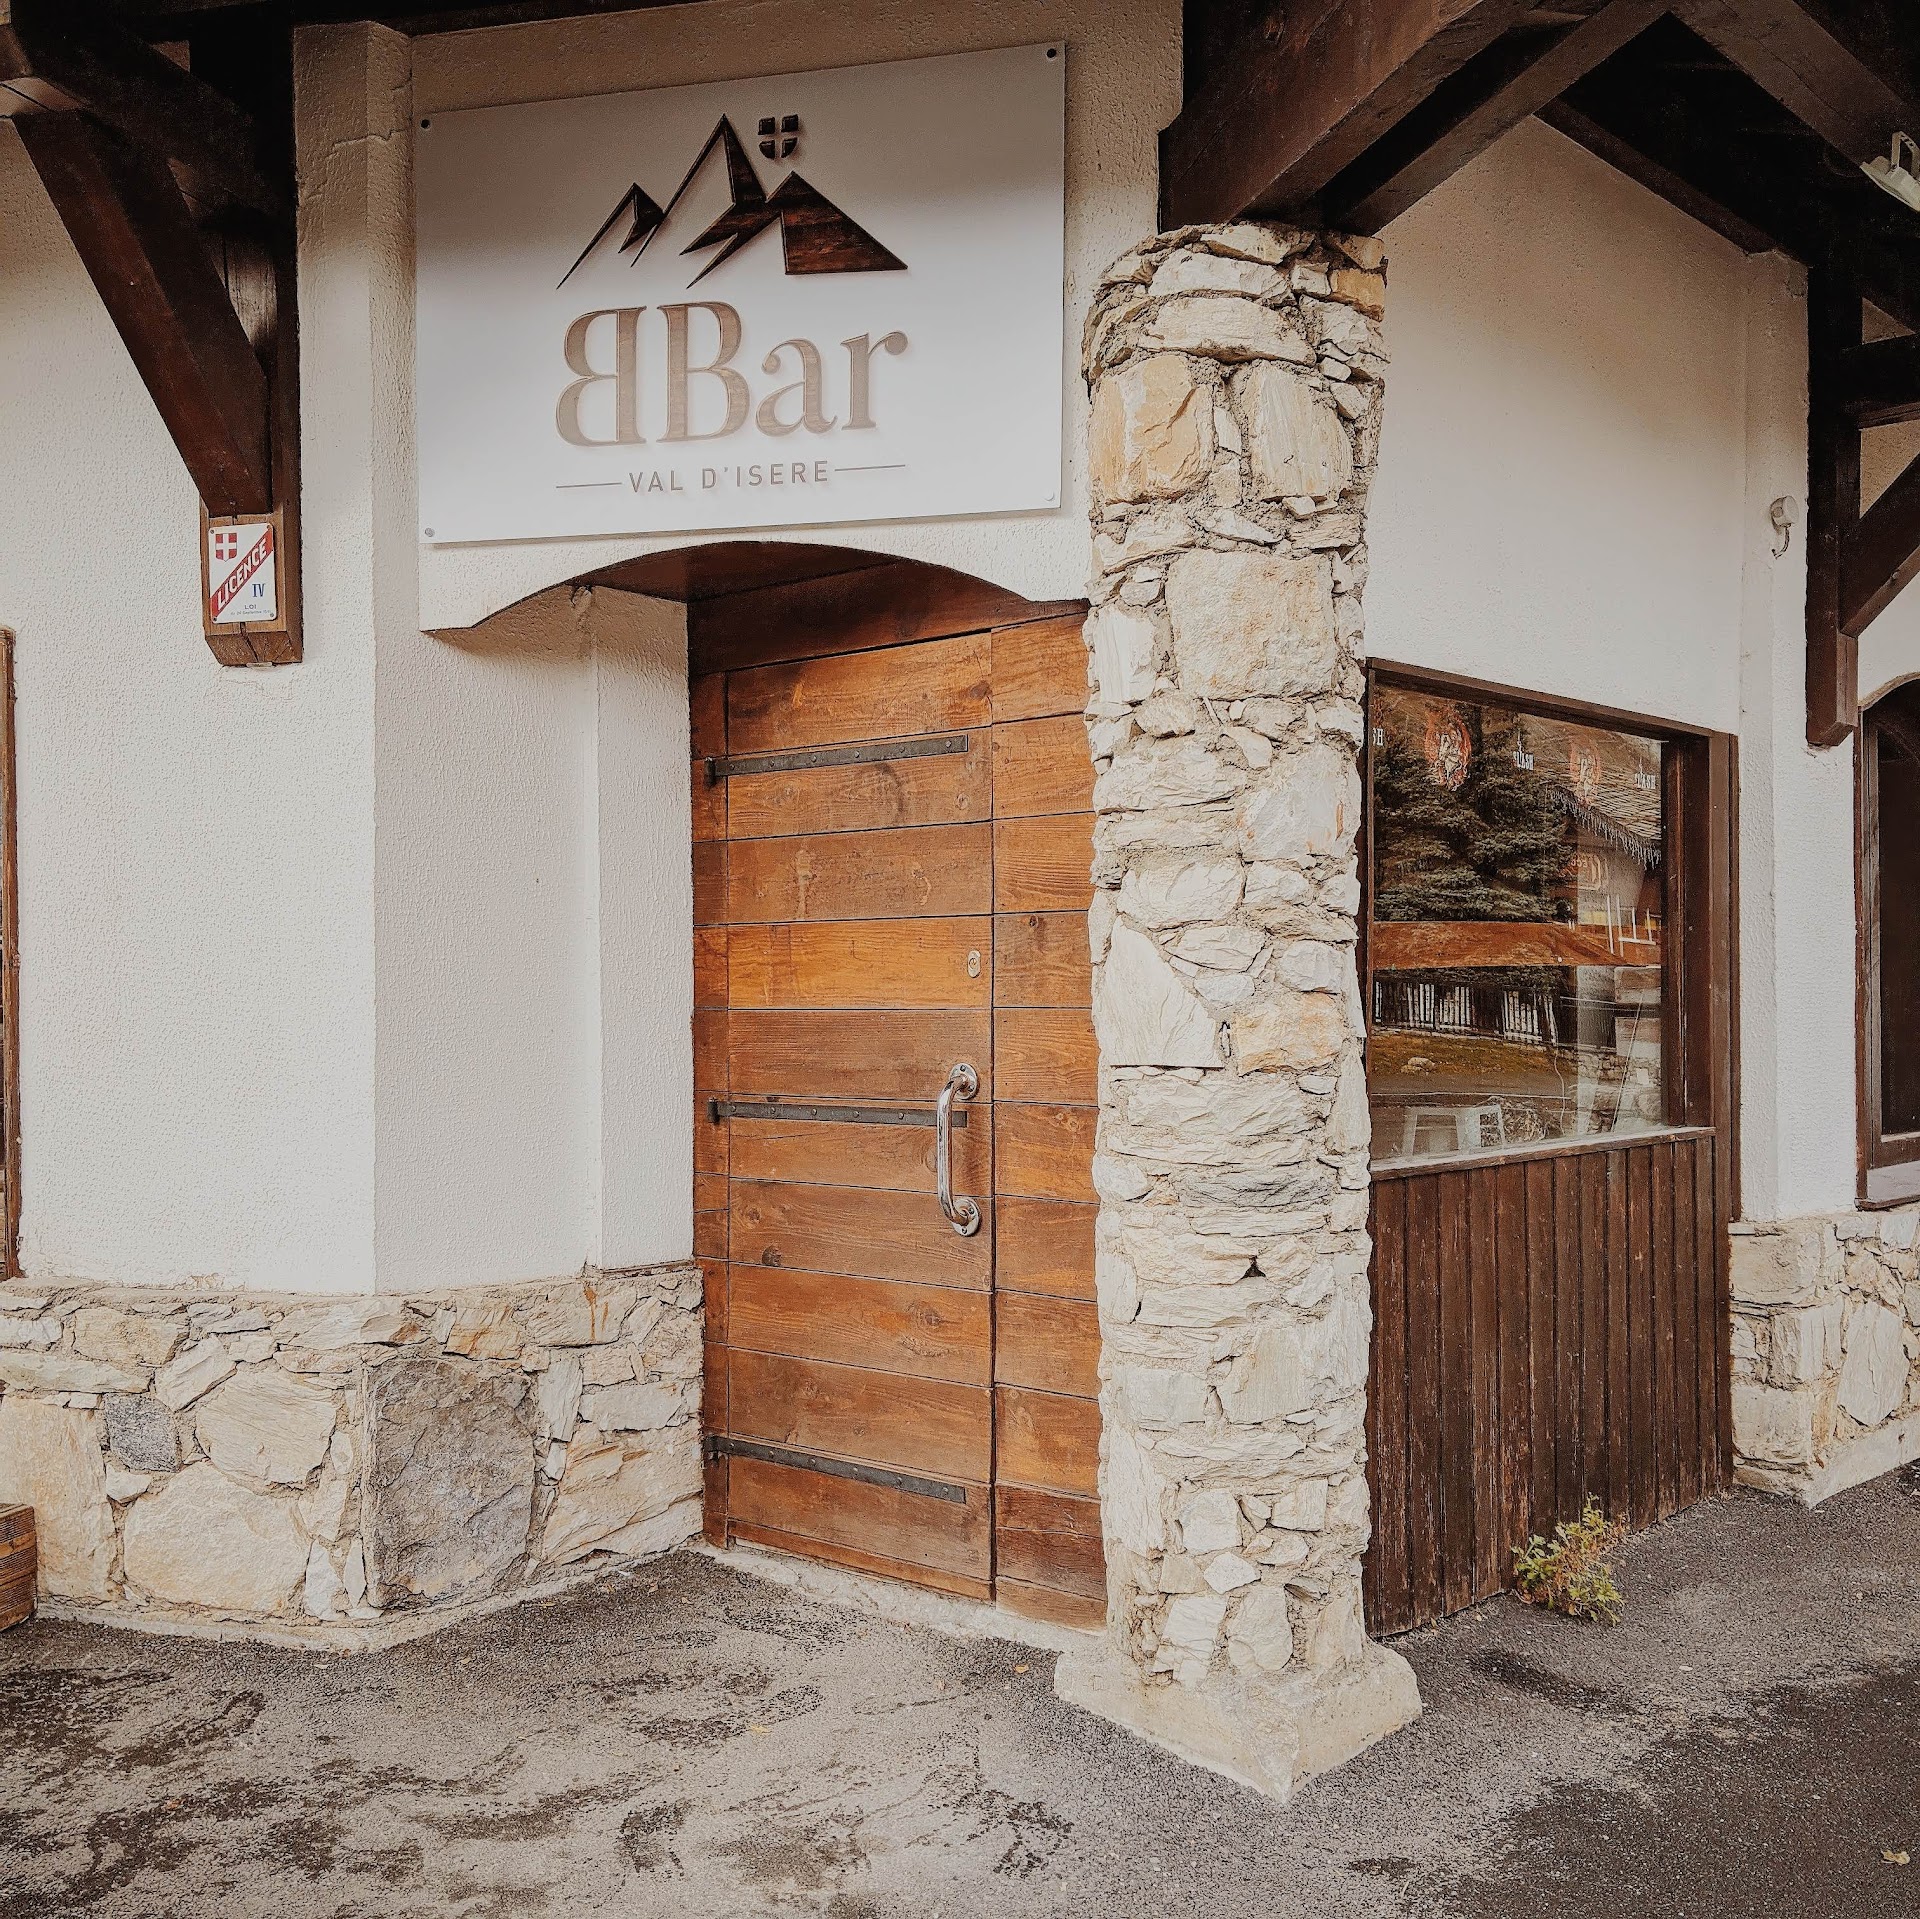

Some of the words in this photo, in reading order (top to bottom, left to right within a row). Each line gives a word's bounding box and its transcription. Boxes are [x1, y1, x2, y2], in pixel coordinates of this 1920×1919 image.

[629, 470, 683, 492] VAL
[702, 460, 828, 489] D'ISERE
[217, 538, 267, 610] LICENCE
[252, 583, 265, 598] IV
